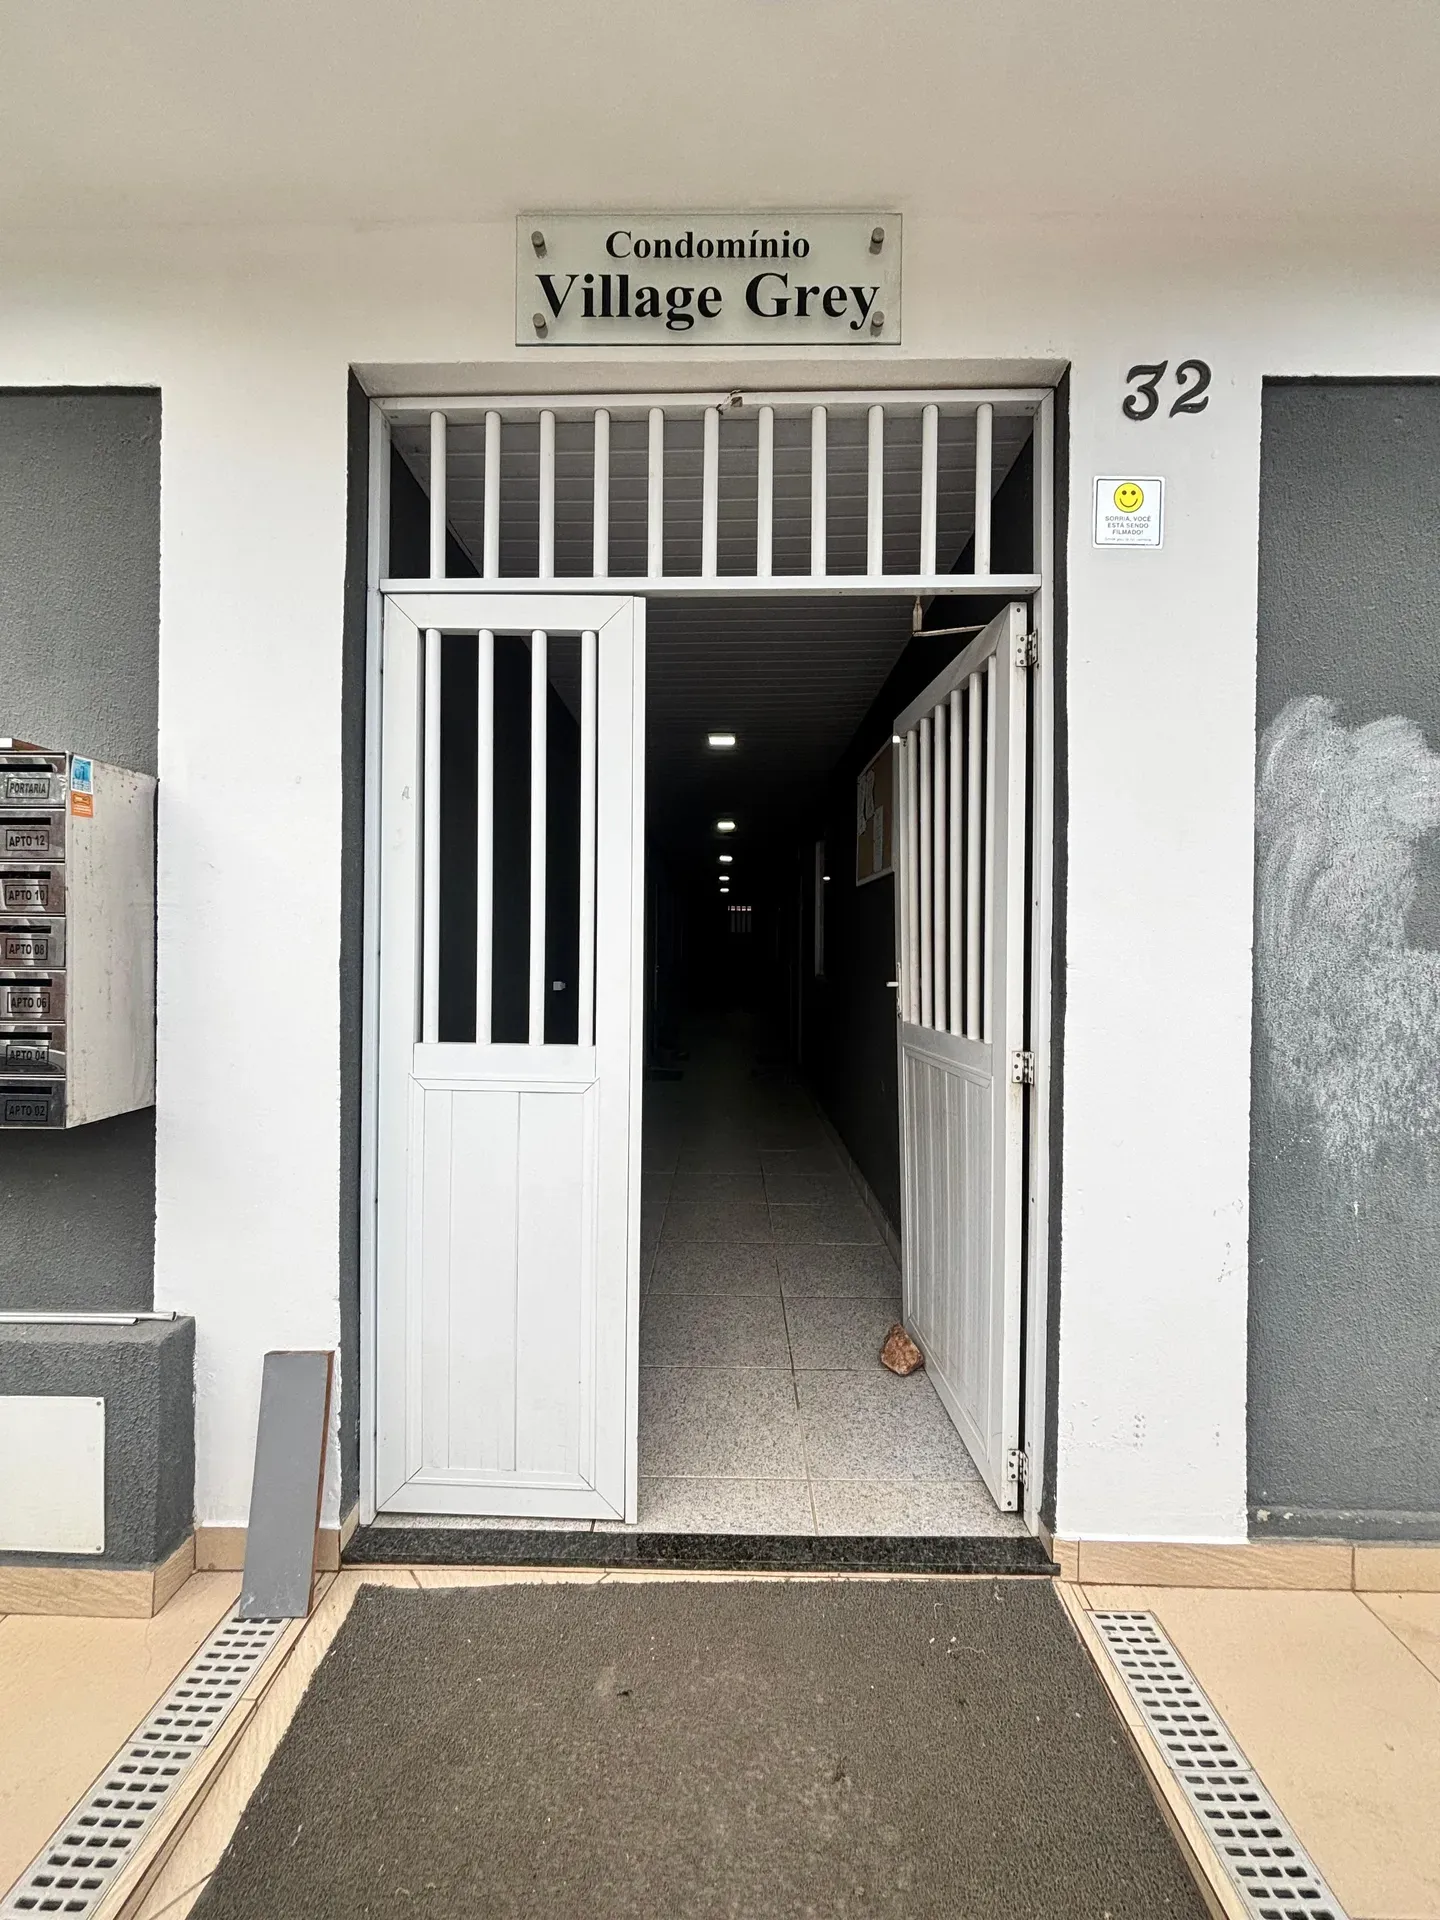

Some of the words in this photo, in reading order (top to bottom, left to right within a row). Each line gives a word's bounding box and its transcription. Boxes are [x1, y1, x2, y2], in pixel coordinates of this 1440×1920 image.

[606, 230, 811, 260] Condomínio
[535, 273, 723, 332] Village
[745, 272, 881, 331] Grey
[1122, 359, 1212, 421] 32
[9, 782, 46, 794] PORTARIA
[9, 836, 32, 847] APTO
[35, 835, 45, 846] 12
[8, 890, 32, 901] APTO
[34, 889, 45, 901] 10
[9, 944, 32, 955] APTO
[34, 944, 45, 955] 08
[11, 997, 34, 1008] APTO
[36, 997, 47, 1008] 06
[10, 1050, 33, 1061] APTO
[35, 1050, 46, 1061] 04
[9, 1103, 32, 1115] APTO
